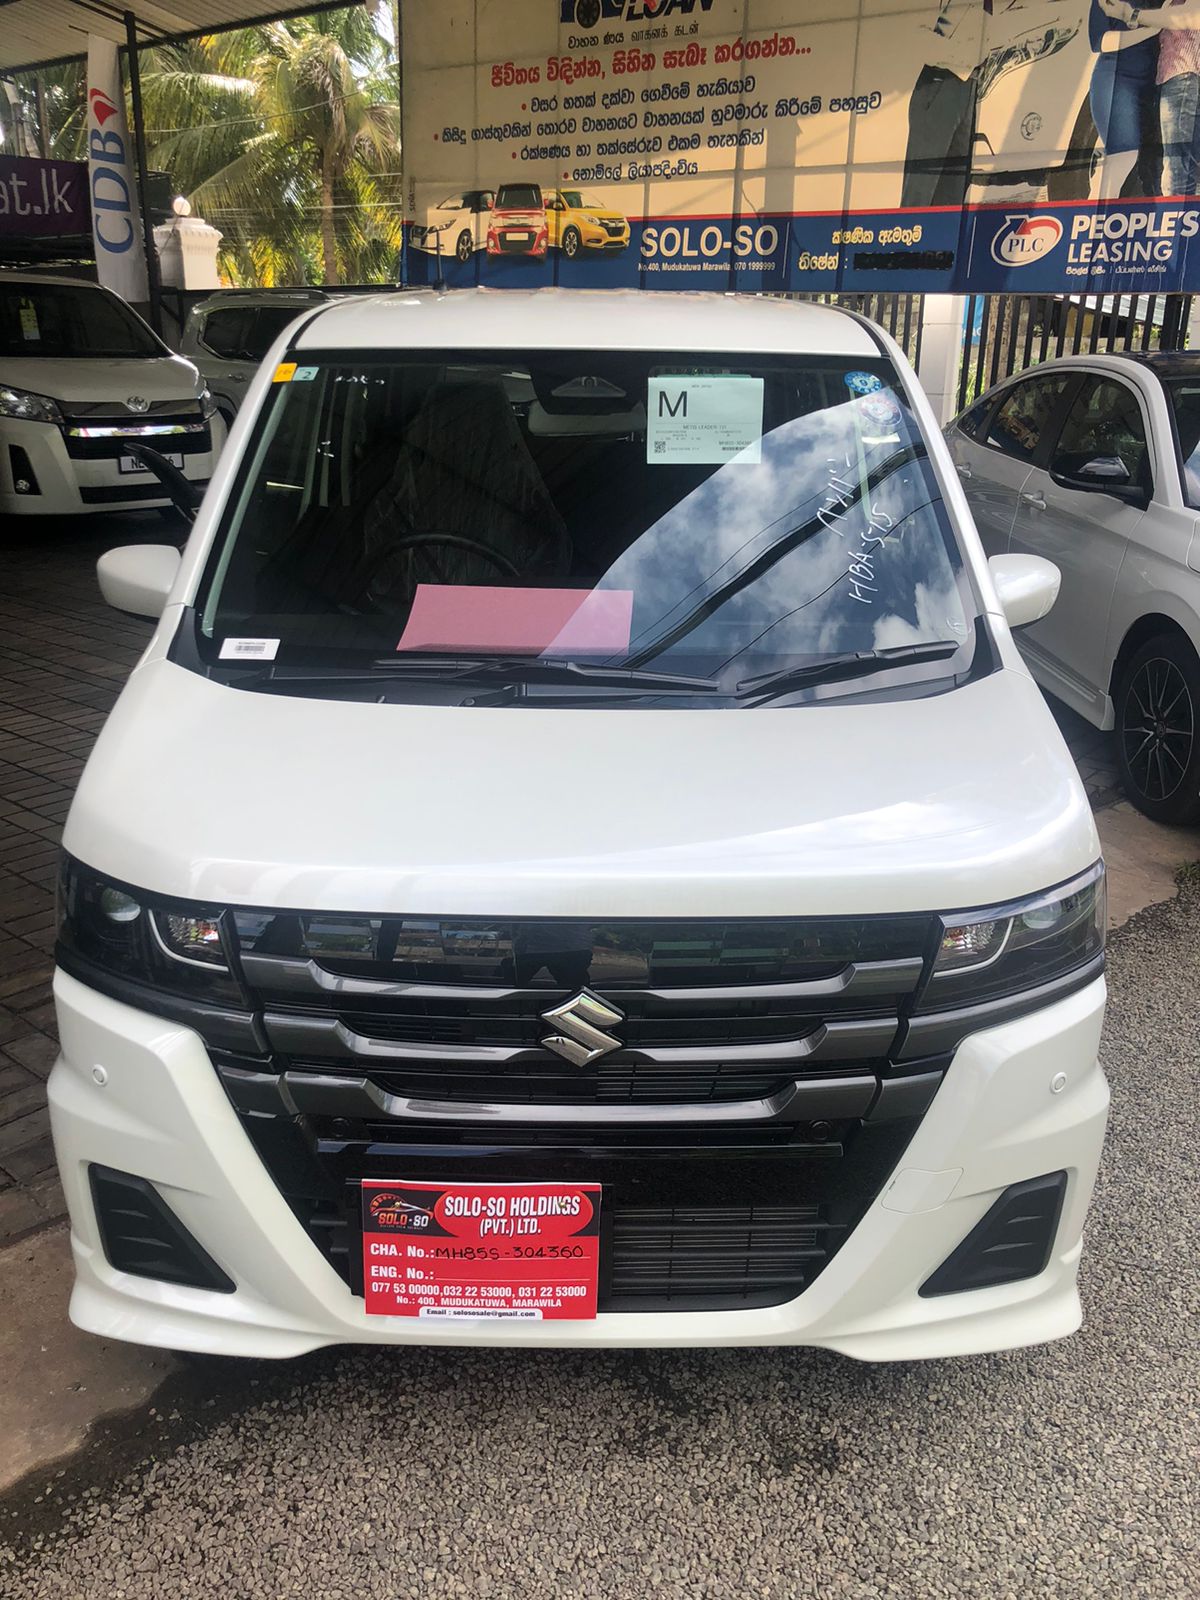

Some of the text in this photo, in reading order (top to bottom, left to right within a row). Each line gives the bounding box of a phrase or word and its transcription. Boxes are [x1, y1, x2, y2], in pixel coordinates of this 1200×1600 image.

[567, 36, 599, 49] වාහන
[612, 48, 656, 74] සිහින
[530, 96, 558, 113] වසර
[563, 89, 596, 110] හතක්
[696, 75, 756, 98] හැකියාව
[537, 117, 576, 136] තොරව
[582, 113, 638, 133] වාහනයට
[643, 106, 705, 128] වාහනයක්
[829, 91, 882, 114] පහසුව
[576, 144, 591, 158] හා
[667, 133, 701, 152] එකම
[90, 128, 134, 254] CDB
[1070, 210, 1200, 240] PEOPLE'S
[640, 225, 779, 257] SOLO-SO
[1007, 237, 1044, 253] PLC
[1067, 240, 1173, 263] LEASING
[662, 261, 701, 271] Mudukatuwa
[734, 262, 746, 271] 070
[658, 390, 688, 417] M
[444, 1195, 580, 1217] SOLO-SO HOLDINGS
[479, 1218, 541, 1238] (PVT.) LTD.
[370, 1243, 402, 1257] CHA.
[370, 1265, 434, 1280] ENG. No.:
[371, 1281, 390, 1293] 077
[393, 1283, 406, 1294] 53
[465, 1286, 477, 1297] 22
[480, 1286, 515, 1298] 53000,
[518, 1286, 536, 1297] 031
[540, 1286, 553, 1297] 22
[555, 1286, 587, 1297] 53000
[396, 1295, 415, 1304] No.:
[440, 1297, 510, 1308] MUDUKATUWA,
[512, 1298, 562, 1307] MARAWILA
[453, 1308, 536, 1317] solososale@gmail.com
